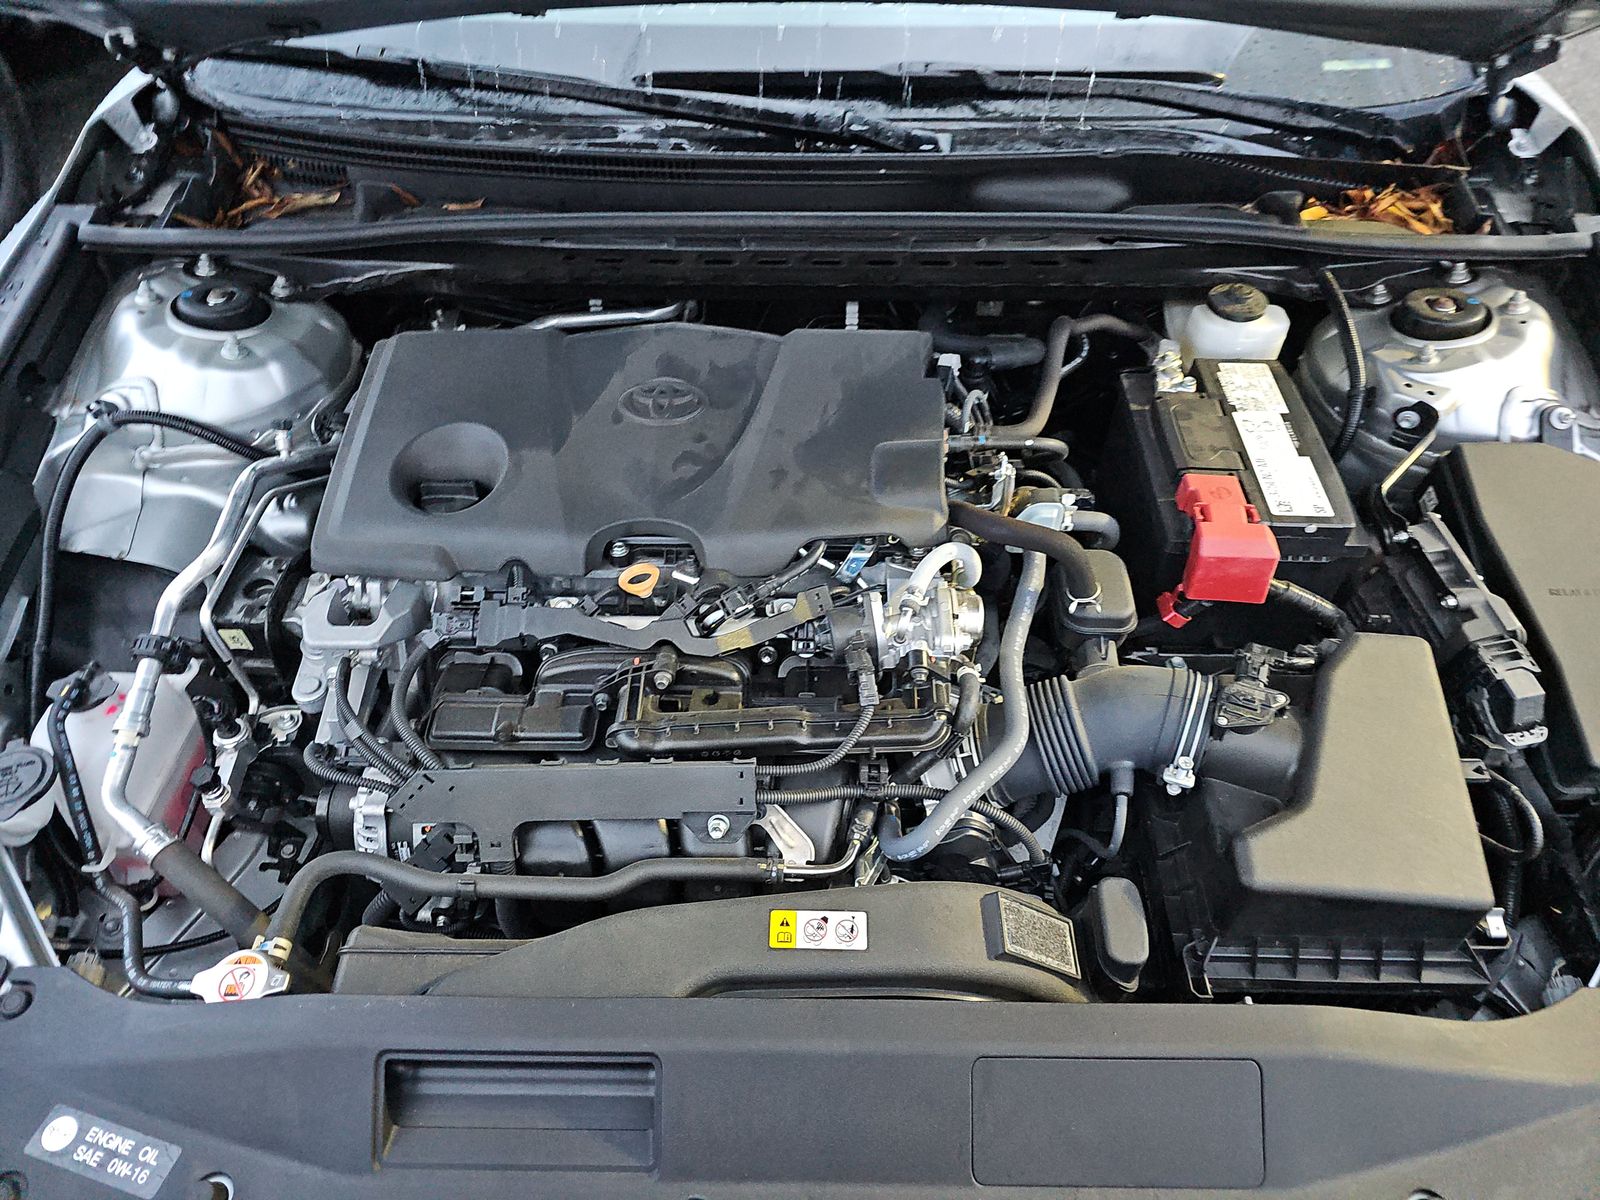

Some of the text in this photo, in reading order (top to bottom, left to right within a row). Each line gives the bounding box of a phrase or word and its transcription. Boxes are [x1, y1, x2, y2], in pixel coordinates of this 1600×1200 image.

[73, 1145, 150, 1184] SAE 0W-16
[85, 1126, 159, 1166] ENGINE OIL
